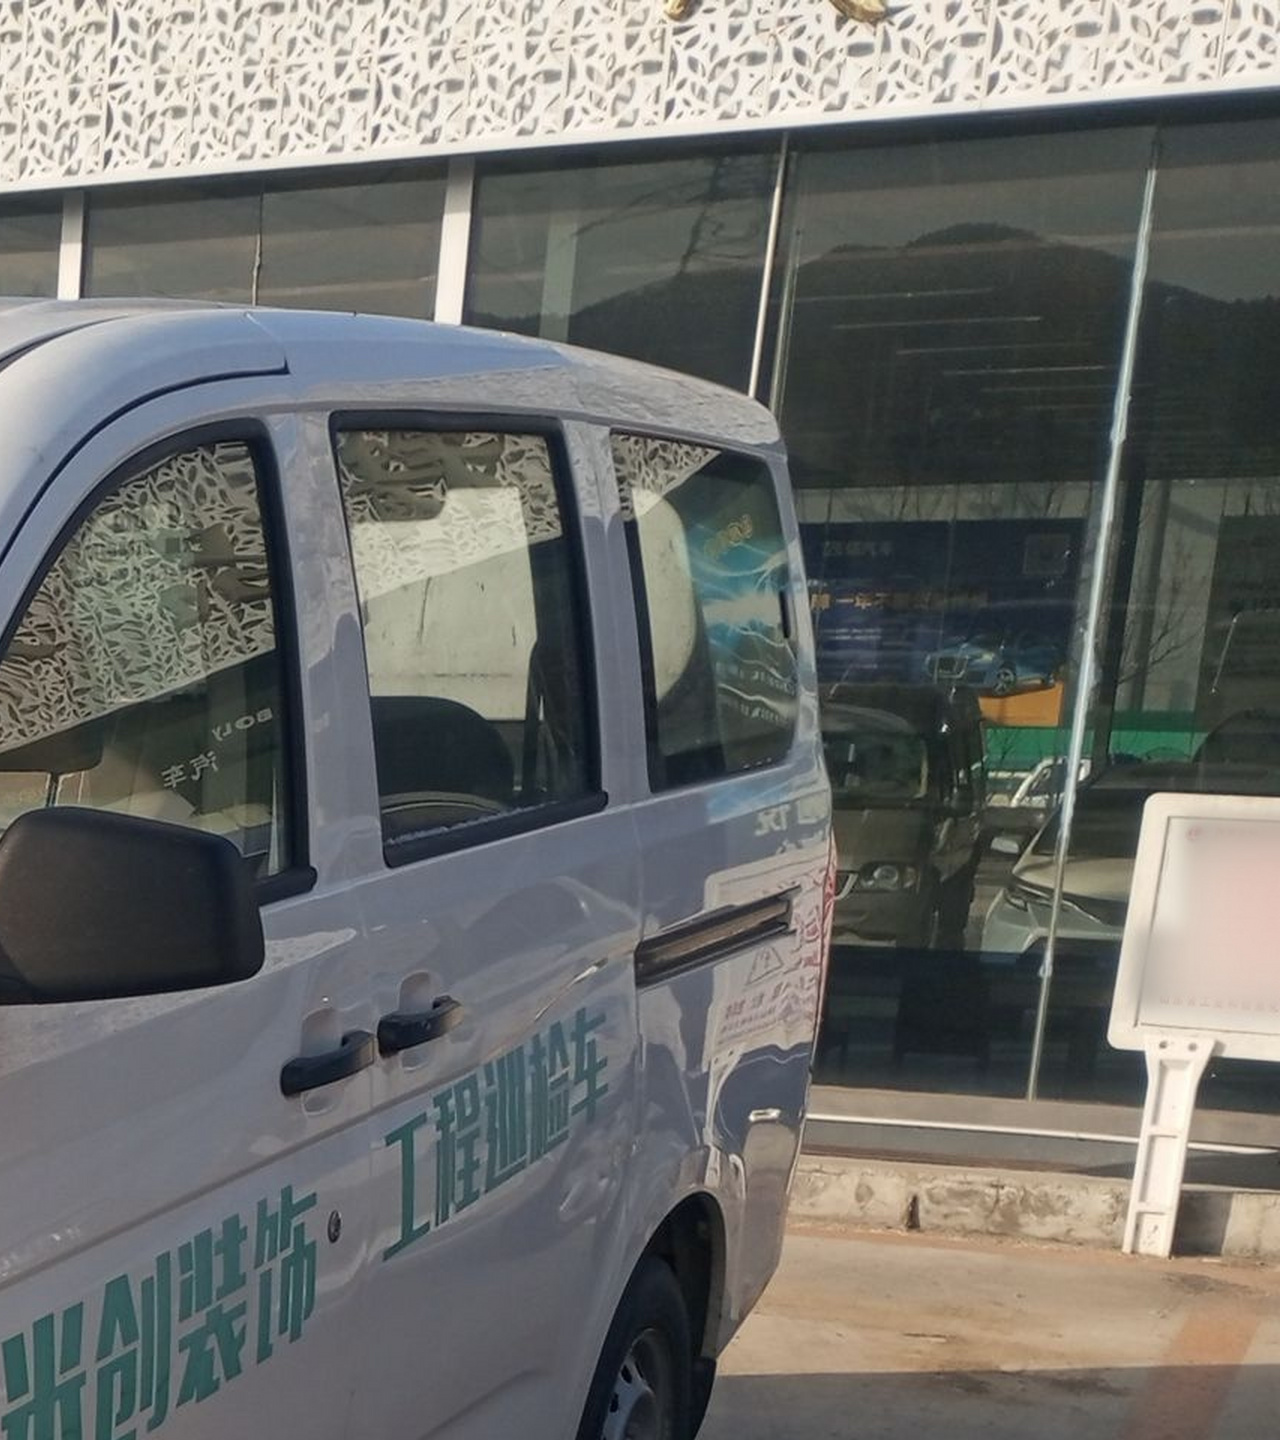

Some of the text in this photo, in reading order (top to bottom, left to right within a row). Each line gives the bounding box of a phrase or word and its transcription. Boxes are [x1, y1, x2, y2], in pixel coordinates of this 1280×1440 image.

[382, 1007, 609, 1262] 工程巡检车
